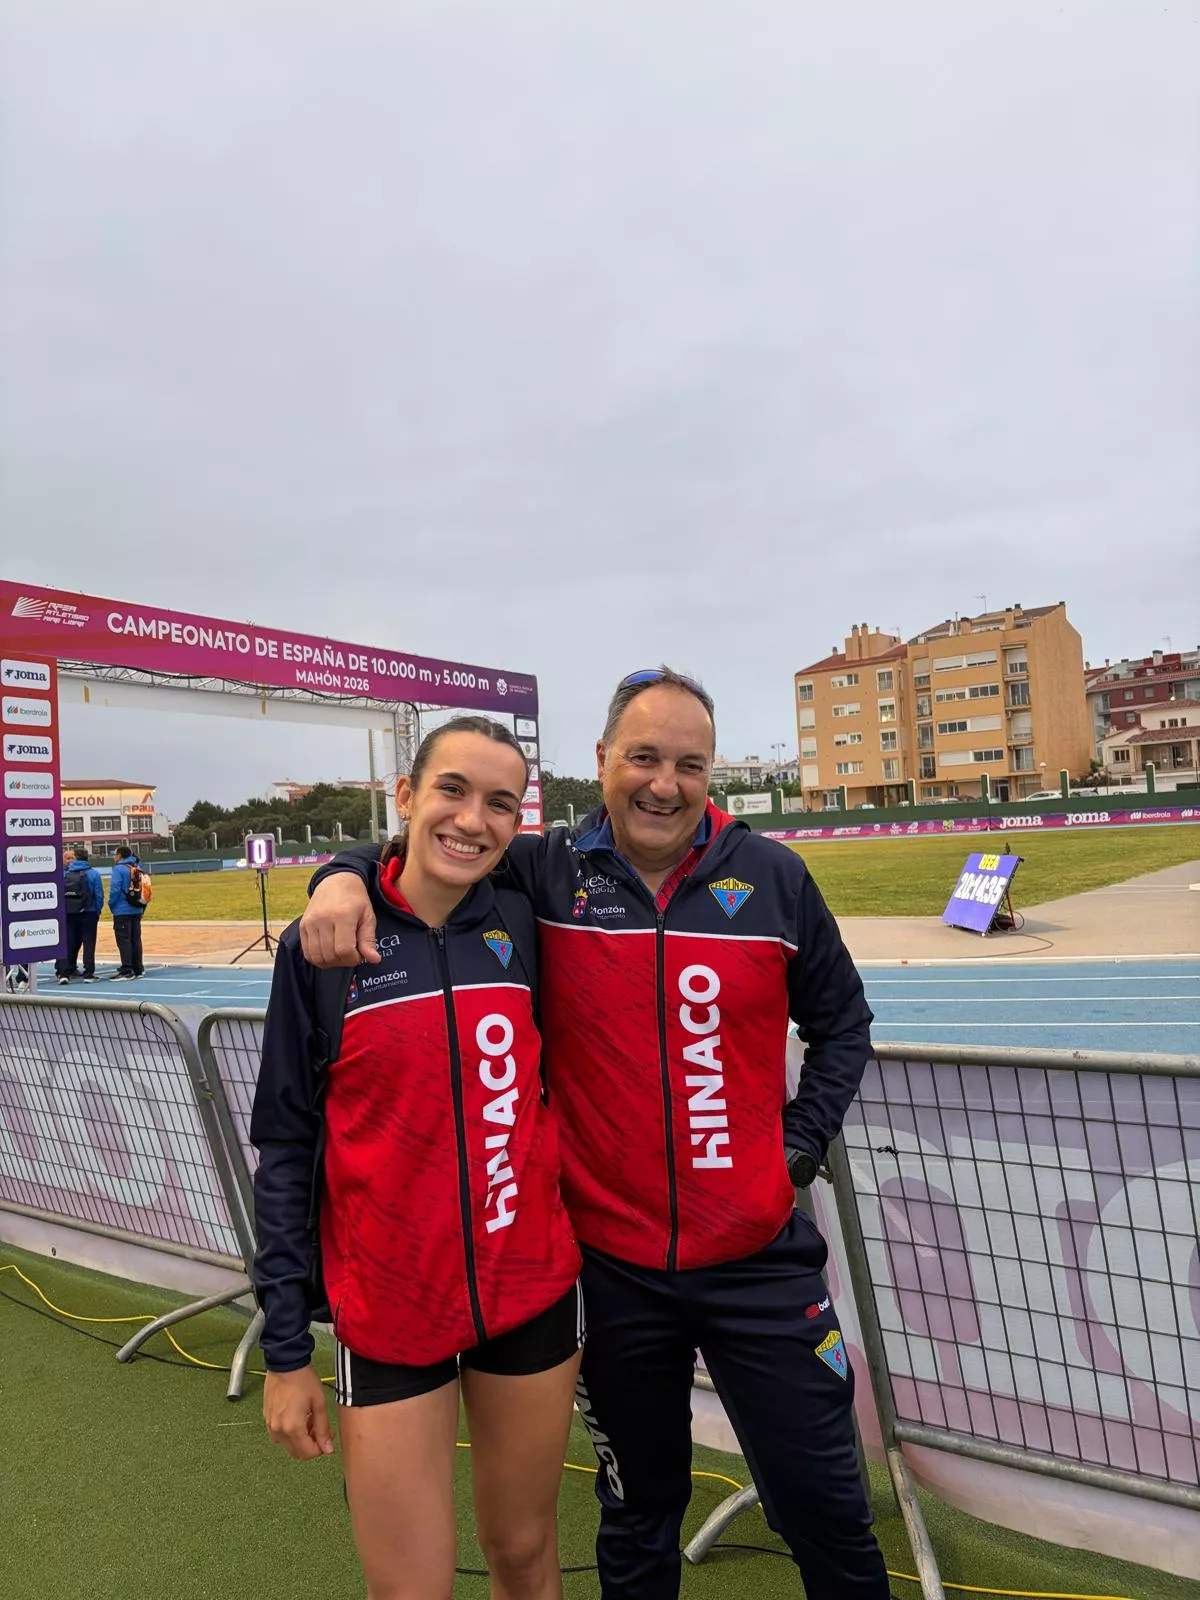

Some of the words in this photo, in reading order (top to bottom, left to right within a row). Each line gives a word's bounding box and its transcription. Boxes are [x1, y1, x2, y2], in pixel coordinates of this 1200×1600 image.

[107, 612, 251, 654] CAMPEONATO
[255, 636, 279, 659] DE
[282, 644, 345, 669] ESPAÑA
[348, 653, 369, 672] DE
[371, 657, 416, 680] 10.000
[419, 667, 432, 683] m
[434, 673, 441, 686] y
[443, 669, 476, 689] 5.000
[478, 678, 490, 690] m
[295, 669, 341, 687] MAHÓN
[343, 676, 370, 691] 2026
[20, 708, 48, 717] Iberdrola
[253, 839, 267, 864] 0
[362, 970, 407, 988] Monzón
[678, 964, 733, 1169] HINACO
